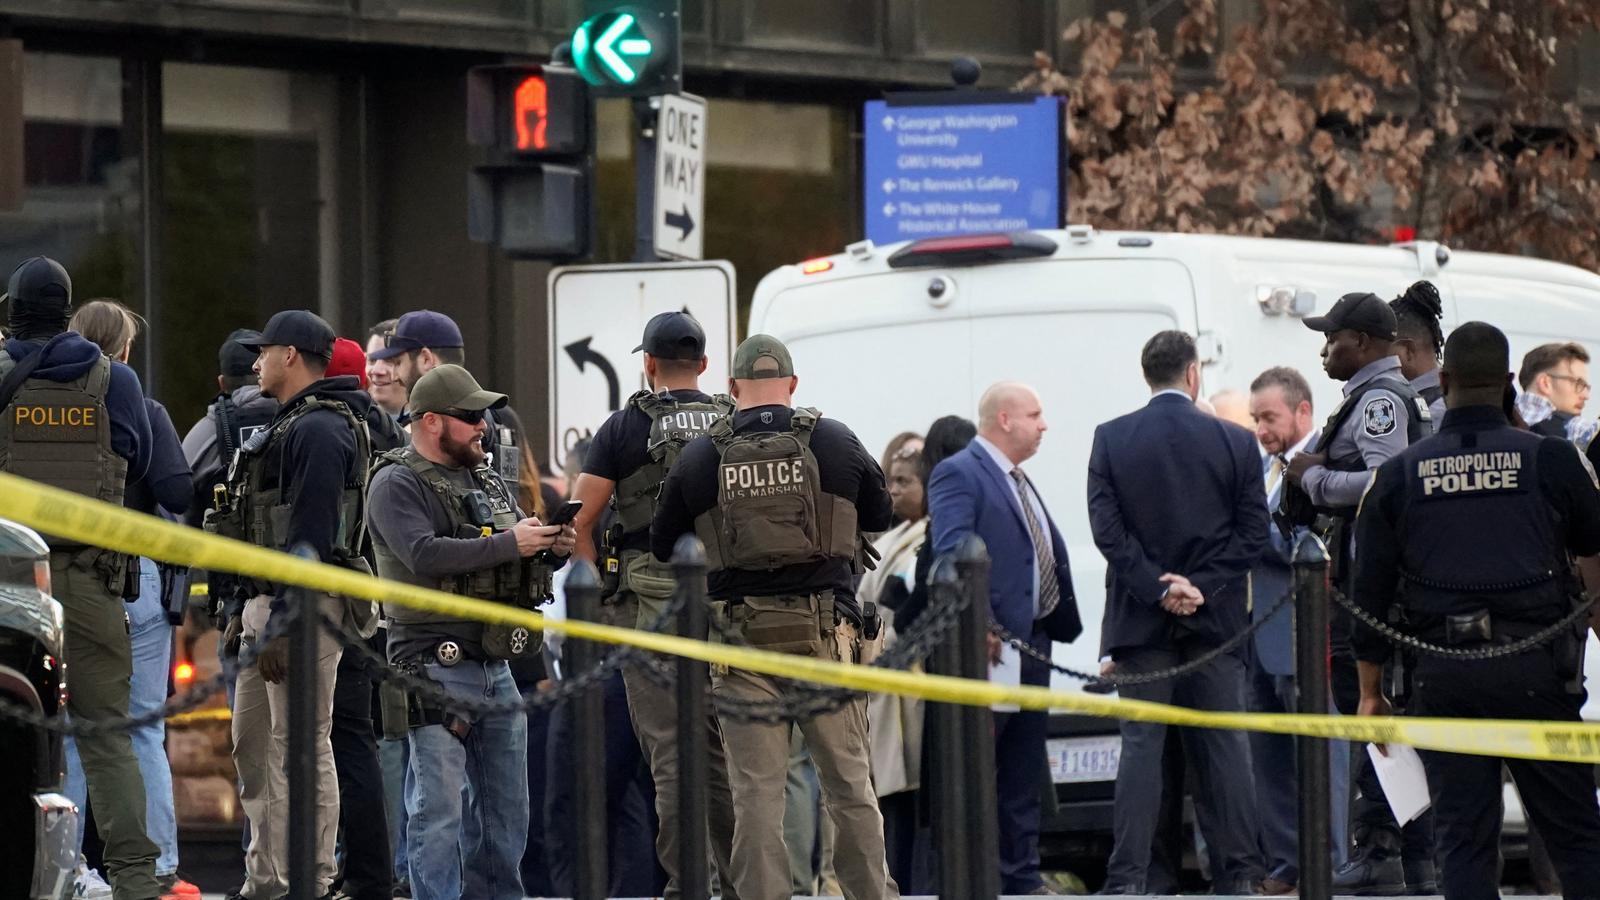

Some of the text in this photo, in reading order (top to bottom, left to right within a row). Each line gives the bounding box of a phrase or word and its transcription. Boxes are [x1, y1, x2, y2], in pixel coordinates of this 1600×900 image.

[667, 106, 699, 150] ONE
[898, 113, 1018, 131] George Washington
[898, 132, 958, 148] University
[898, 152, 983, 169] GWU Hospital
[664, 151, 699, 194] WAY
[899, 178, 920, 192] The
[976, 176, 1019, 193] Gallery
[899, 202, 1001, 216] The White House
[898, 217, 1028, 232] Historical Association
[16, 406, 95, 426] POLICE
[1418, 452, 1522, 478] METROPOLITAN
[725, 460, 804, 490] POLICE
[1423, 470, 1519, 496] POLICE
